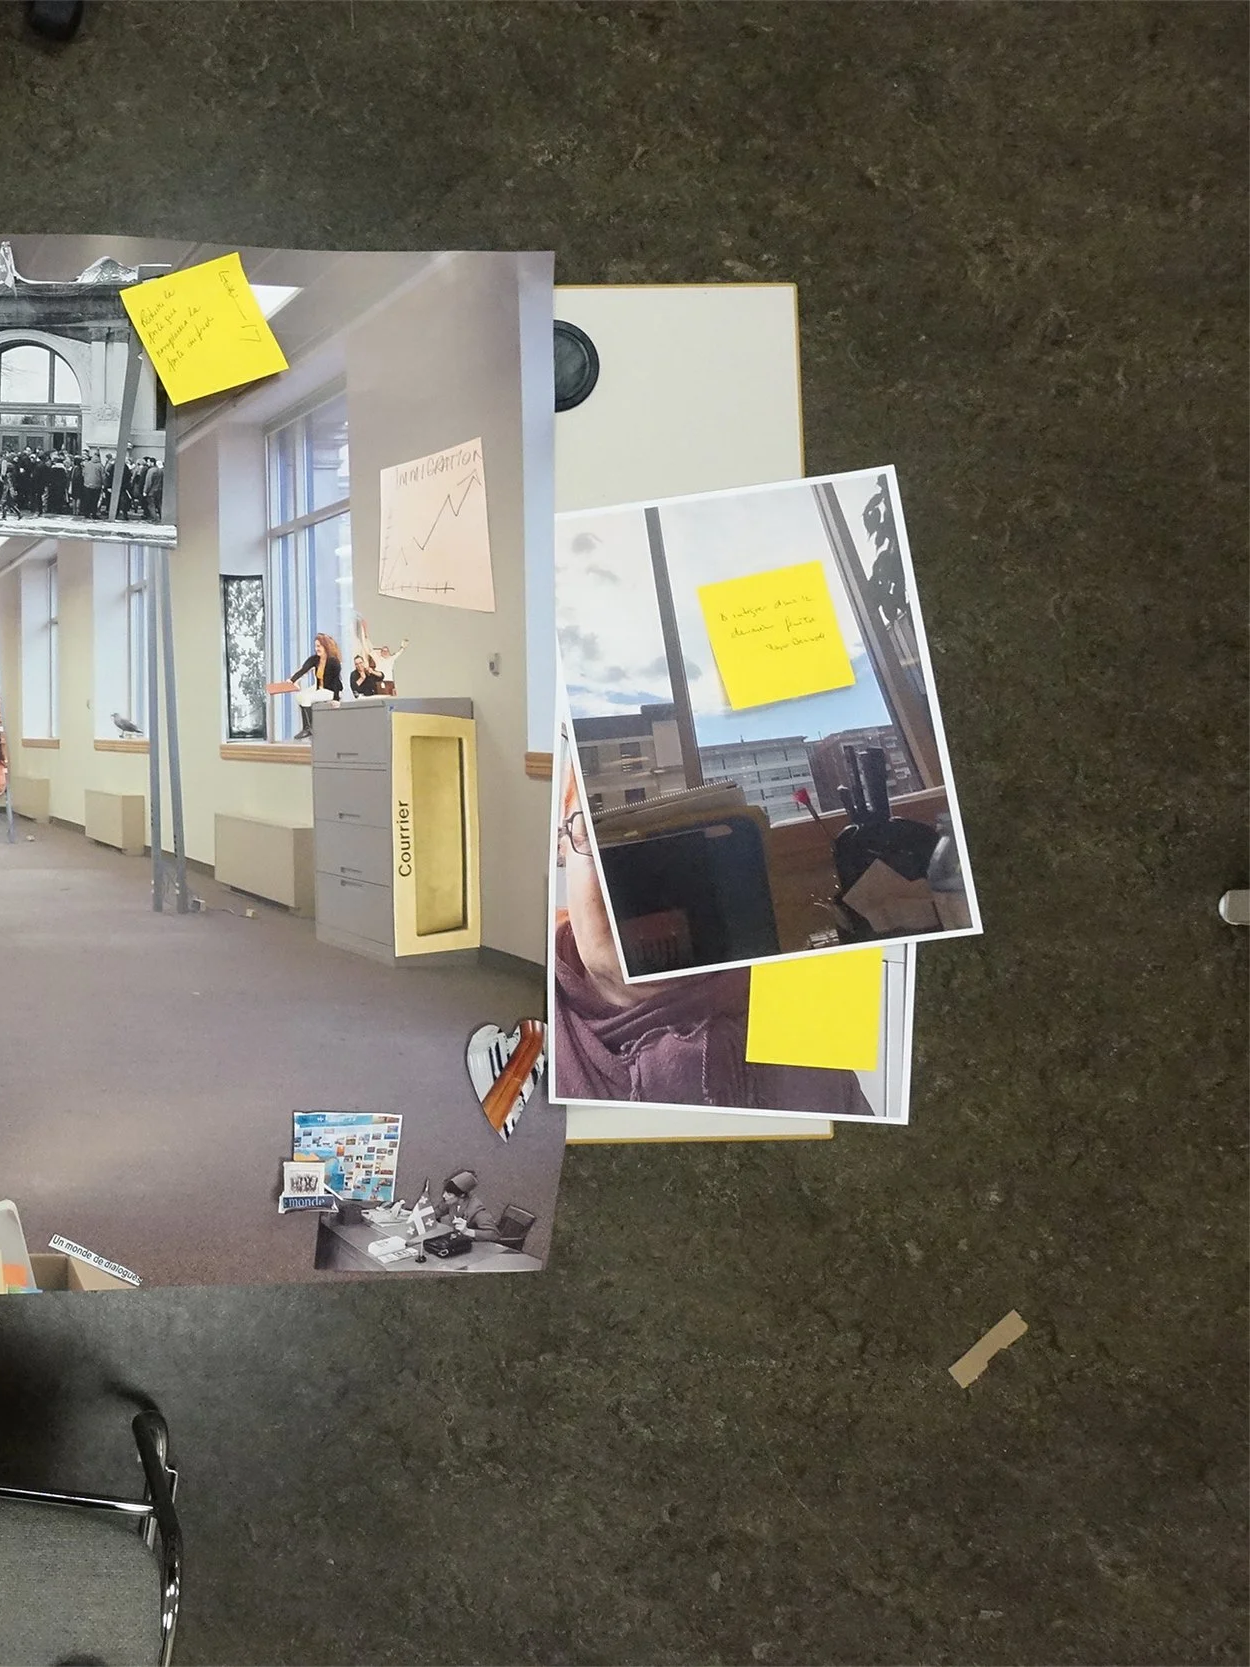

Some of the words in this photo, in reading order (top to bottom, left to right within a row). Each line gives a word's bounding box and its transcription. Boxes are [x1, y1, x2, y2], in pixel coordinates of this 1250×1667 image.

[398, 800, 412, 877] Courrier
[290, 1197, 325, 1208] monde
[52, 1235, 64, 1247] Un
[65, 1241, 92, 1260] monde
[93, 1256, 104, 1266] de
